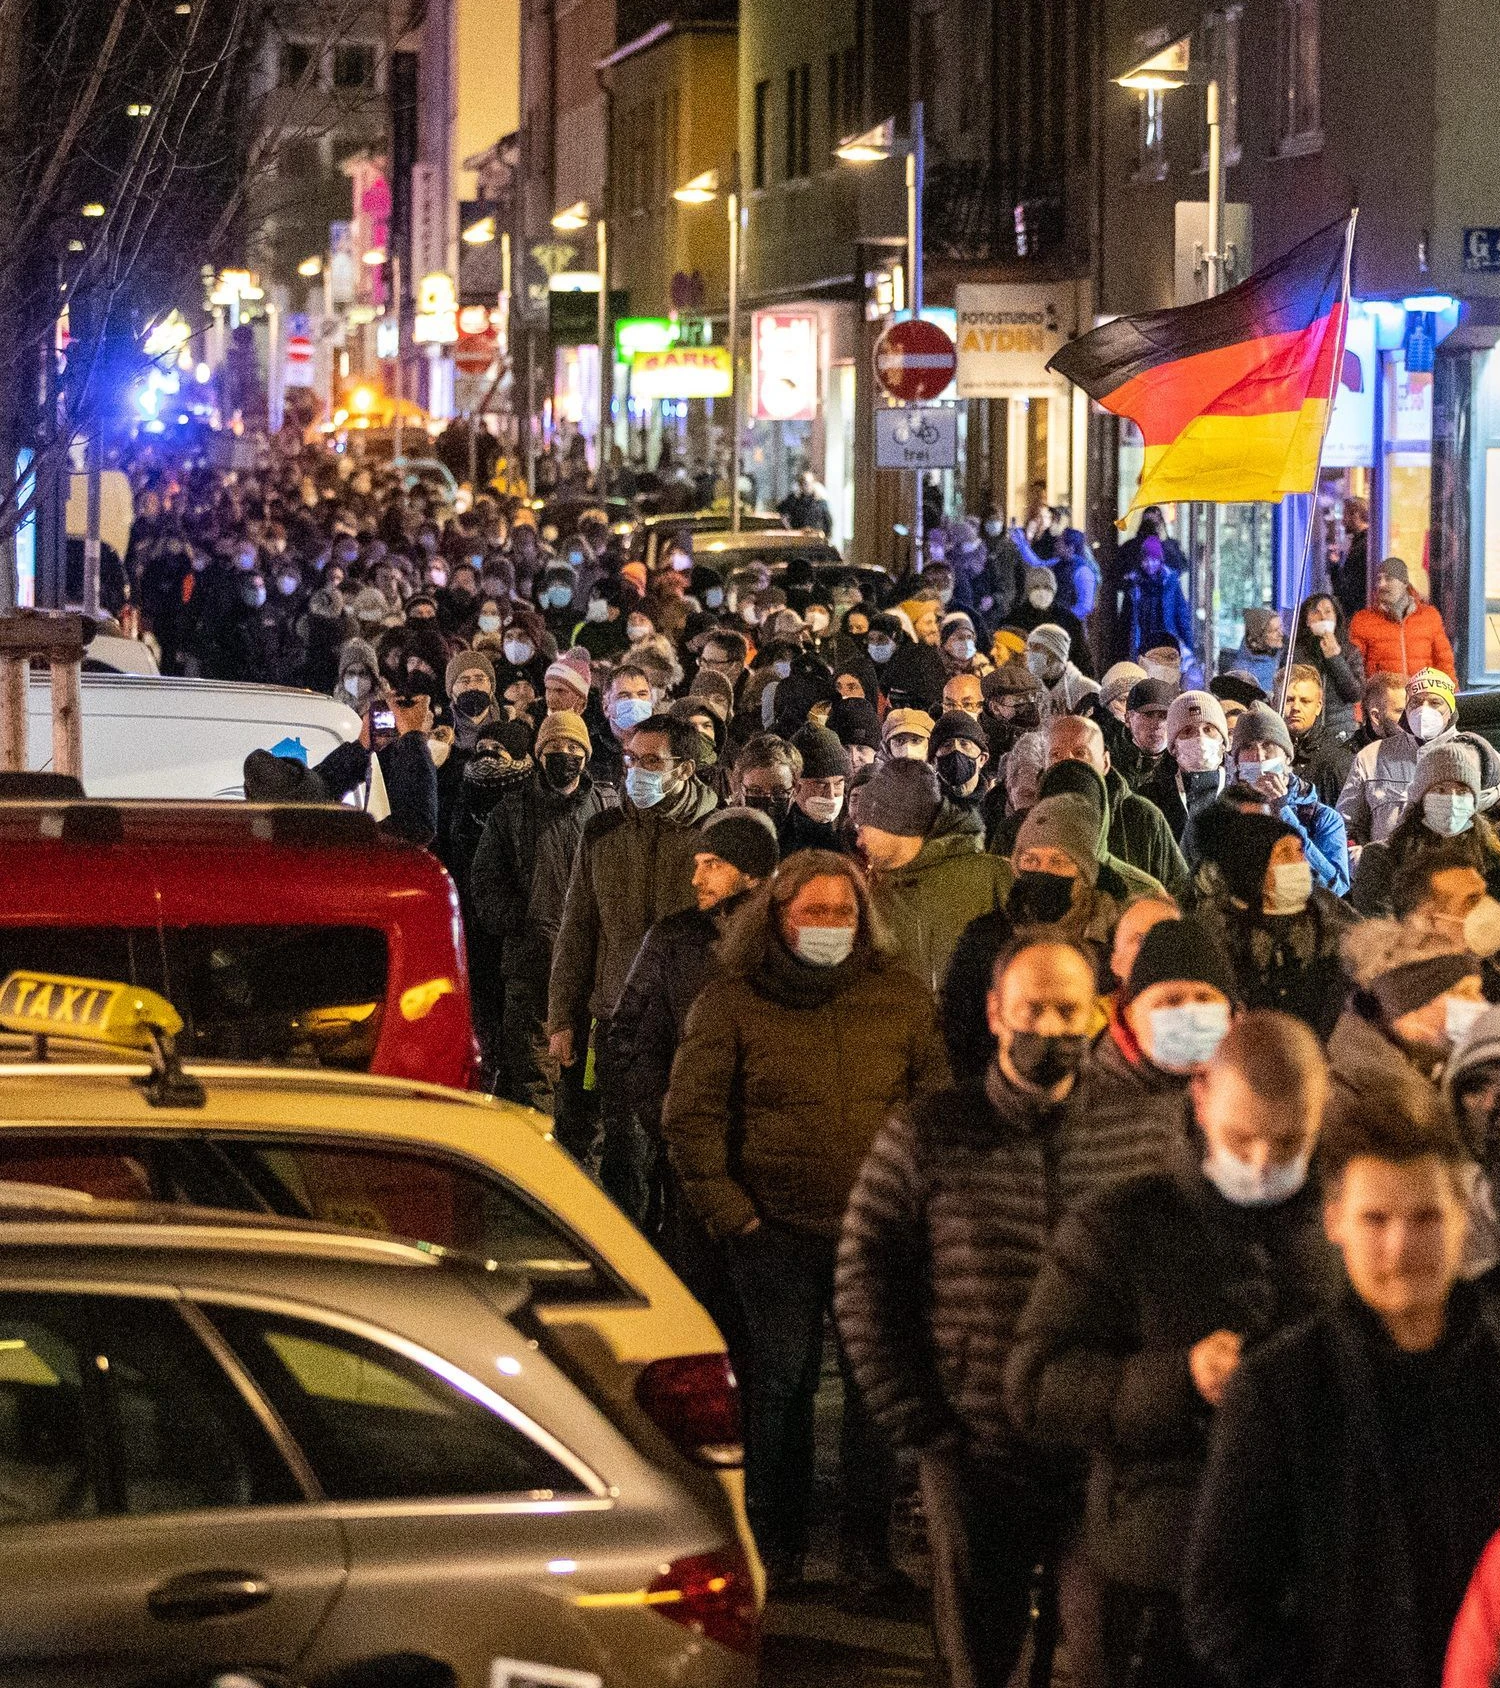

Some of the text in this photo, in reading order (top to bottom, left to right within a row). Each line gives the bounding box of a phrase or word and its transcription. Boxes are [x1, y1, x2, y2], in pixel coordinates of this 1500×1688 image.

[1469, 231, 1490, 258] G
[961, 312, 1043, 325] FOTOSTUDIO
[961, 328, 1044, 352] AYDIN
[904, 447, 929, 460] frei
[14, 980, 99, 1025] TAXI
